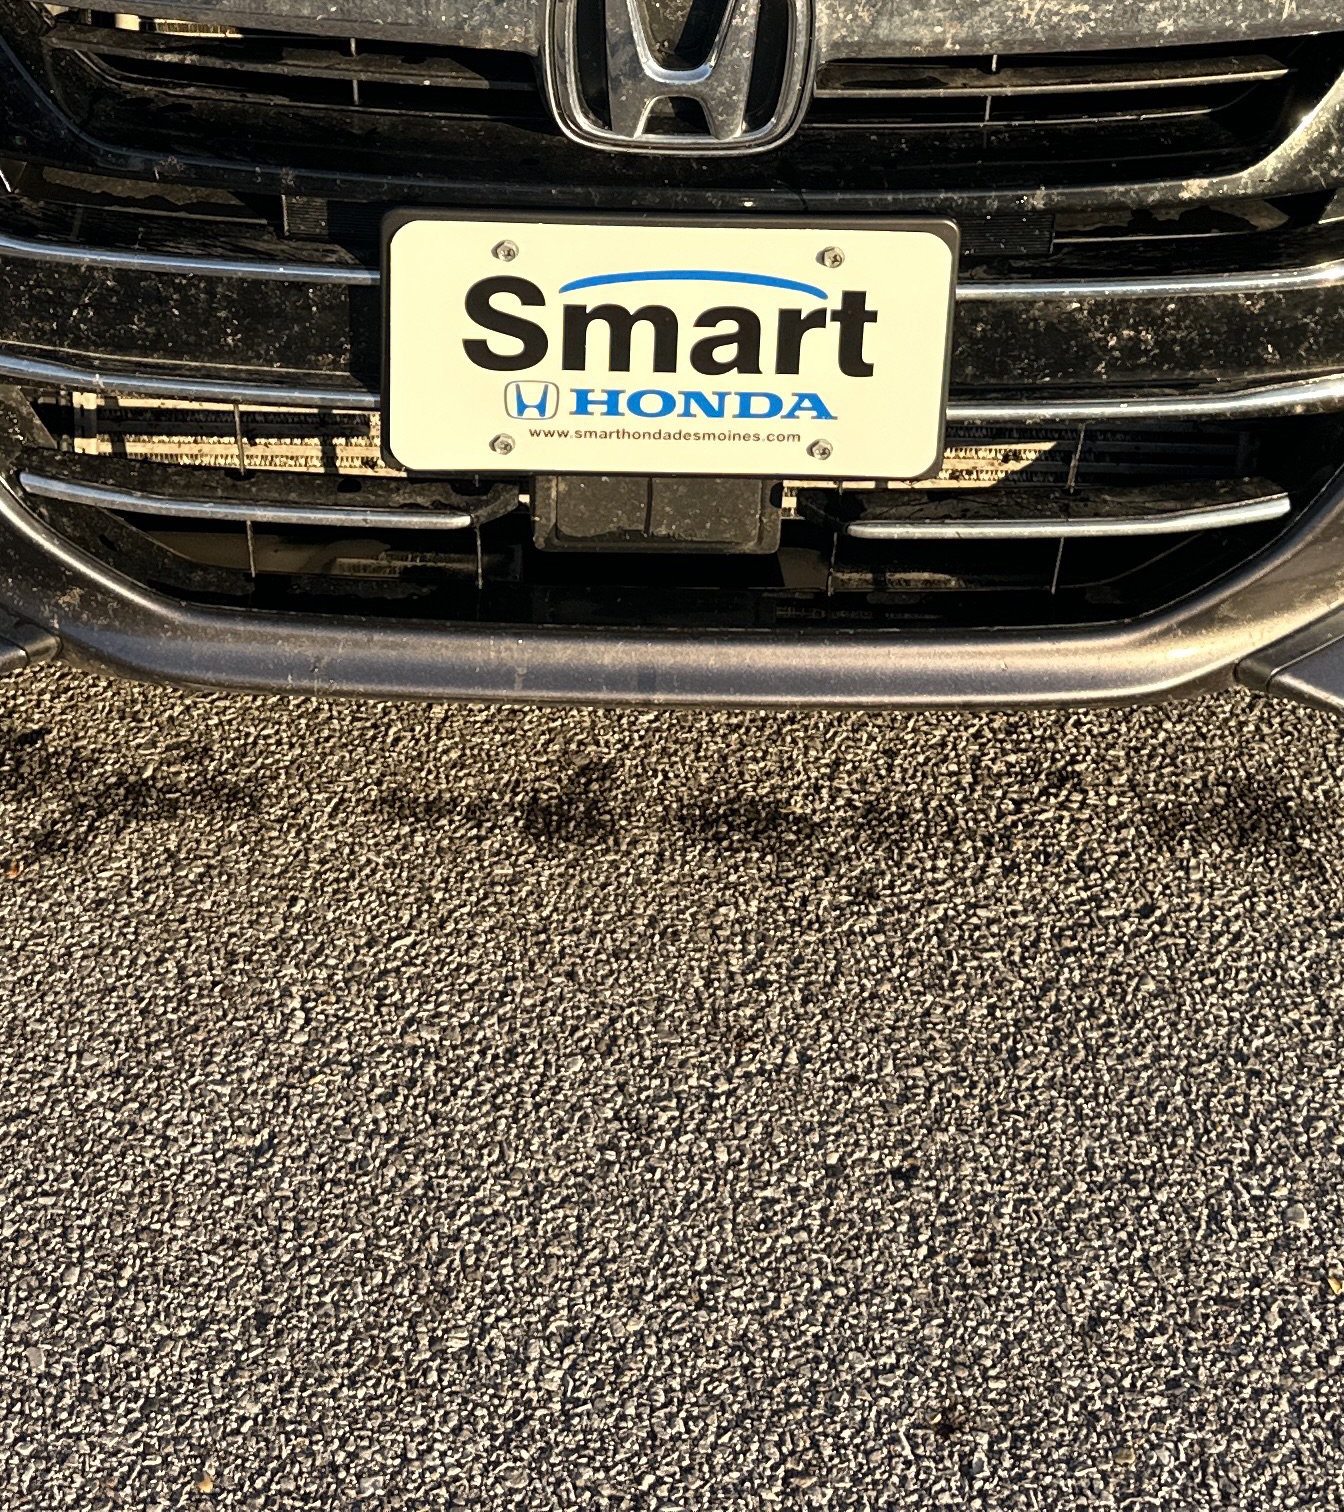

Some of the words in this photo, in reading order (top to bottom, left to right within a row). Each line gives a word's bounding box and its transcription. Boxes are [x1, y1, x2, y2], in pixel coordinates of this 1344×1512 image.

[462, 275, 878, 377] Smart
[568, 388, 838, 420] HONDA
[528, 428, 801, 443] www.smarthondadesmoines.com
